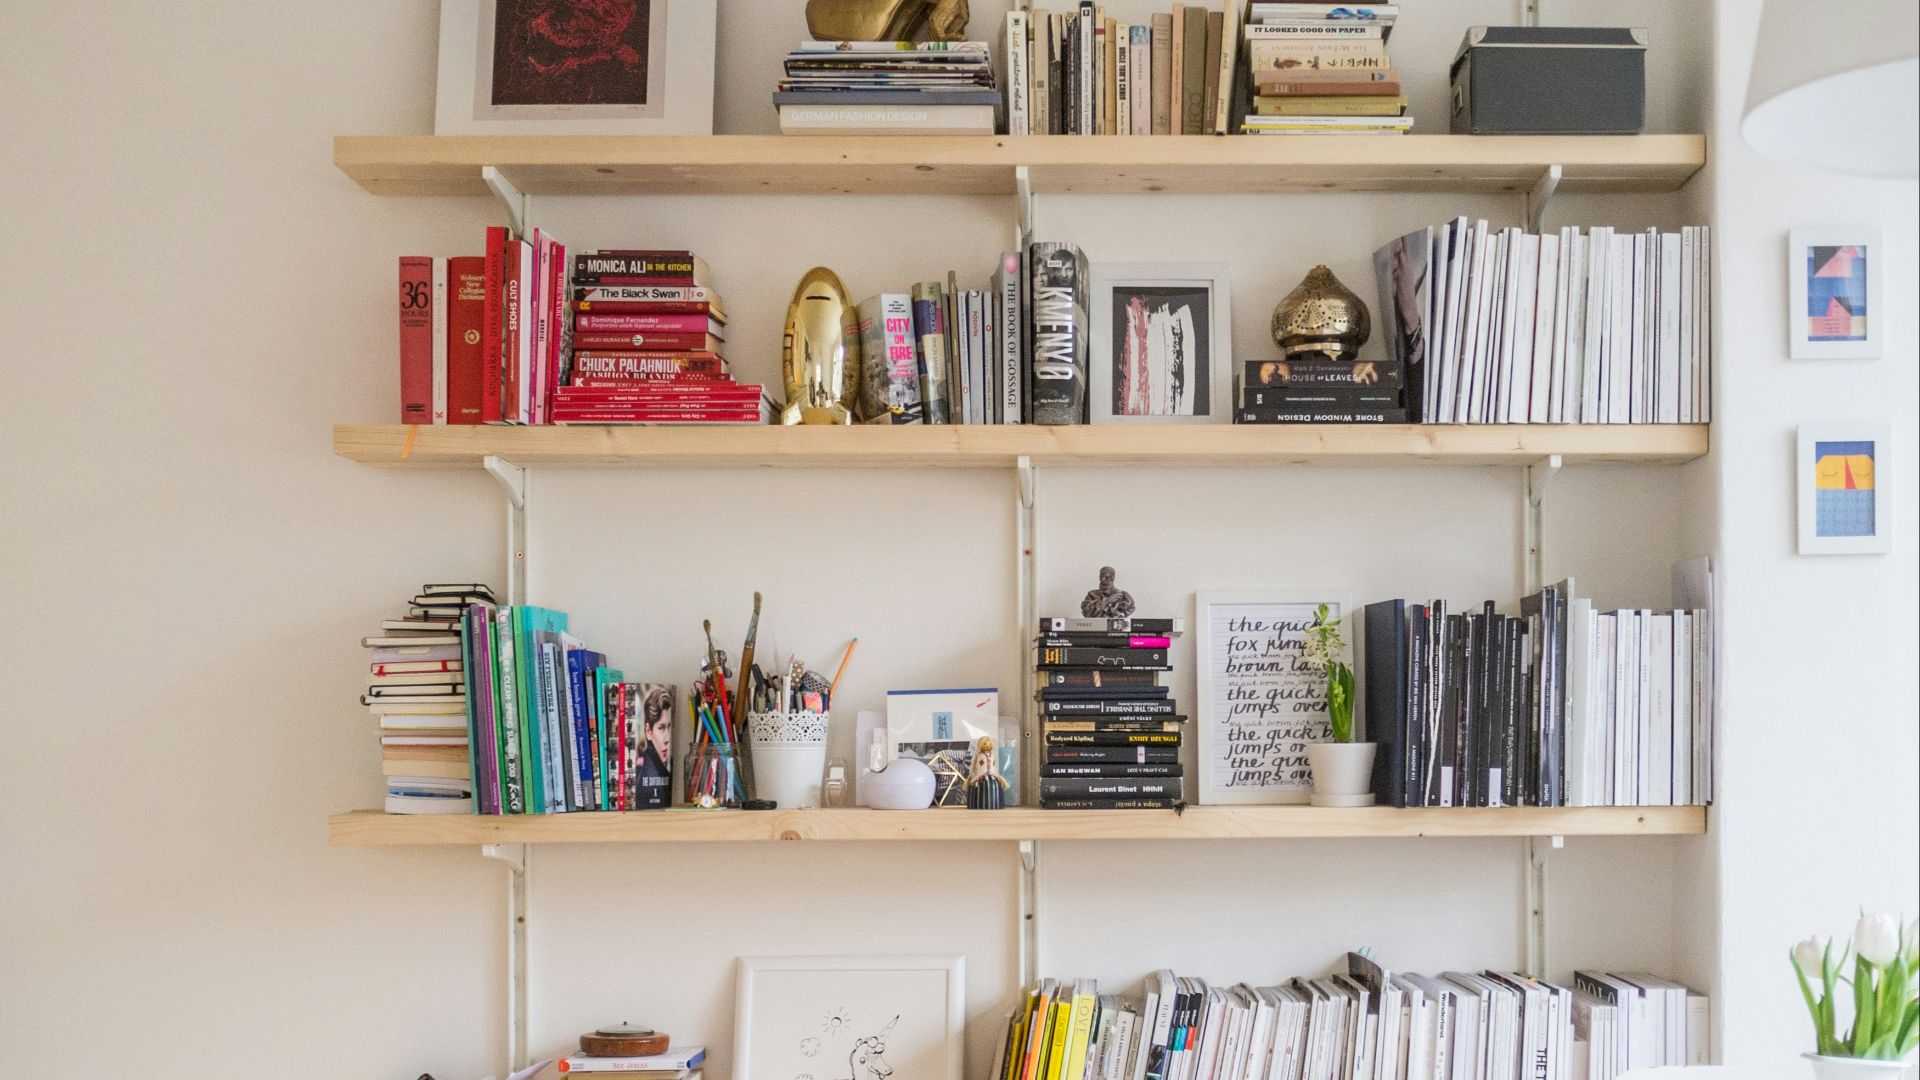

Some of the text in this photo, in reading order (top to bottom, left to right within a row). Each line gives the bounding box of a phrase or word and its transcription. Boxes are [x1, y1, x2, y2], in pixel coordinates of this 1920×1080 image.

[791, 110, 927, 122] GERMAN FASHION DESIGN
[588, 260, 692, 274] MONICA ALI IN THE KITCHEN
[402, 281, 429, 309] 36
[600, 288, 681, 298] The Black Swan
[401, 310, 430, 318] HOURS
[509, 279, 518, 330] CULT SHOES
[591, 316, 624, 324] Dominique
[886, 318, 911, 333] CITY
[1036, 286, 1073, 364] KMENY
[894, 334, 905, 345] ON
[1008, 281, 1016, 409] THE BOOK OF GOSSAGE
[890, 346, 913, 361] FIRE
[579, 358, 681, 373] CHUCK PALAHNIUK
[585, 372, 676, 380] FASHION BRANDS
[1228, 616, 1270, 632] the
[1226, 635, 1318, 658] fox jump
[1226, 658, 1284, 674] brown
[504, 676, 512, 700] CLEAN
[1226, 684, 1321, 708] the quick
[1222, 701, 1329, 724] jumps over
[1228, 726, 1261, 742] the
[1266, 726, 1317, 750] quick
[1224, 742, 1281, 760] jumps
[1230, 756, 1310, 776] the quic
[1226, 768, 1314, 788] jumps ove
[1077, 998, 1091, 1035] LOVE
[1536, 1048, 1547, 1071] THE
